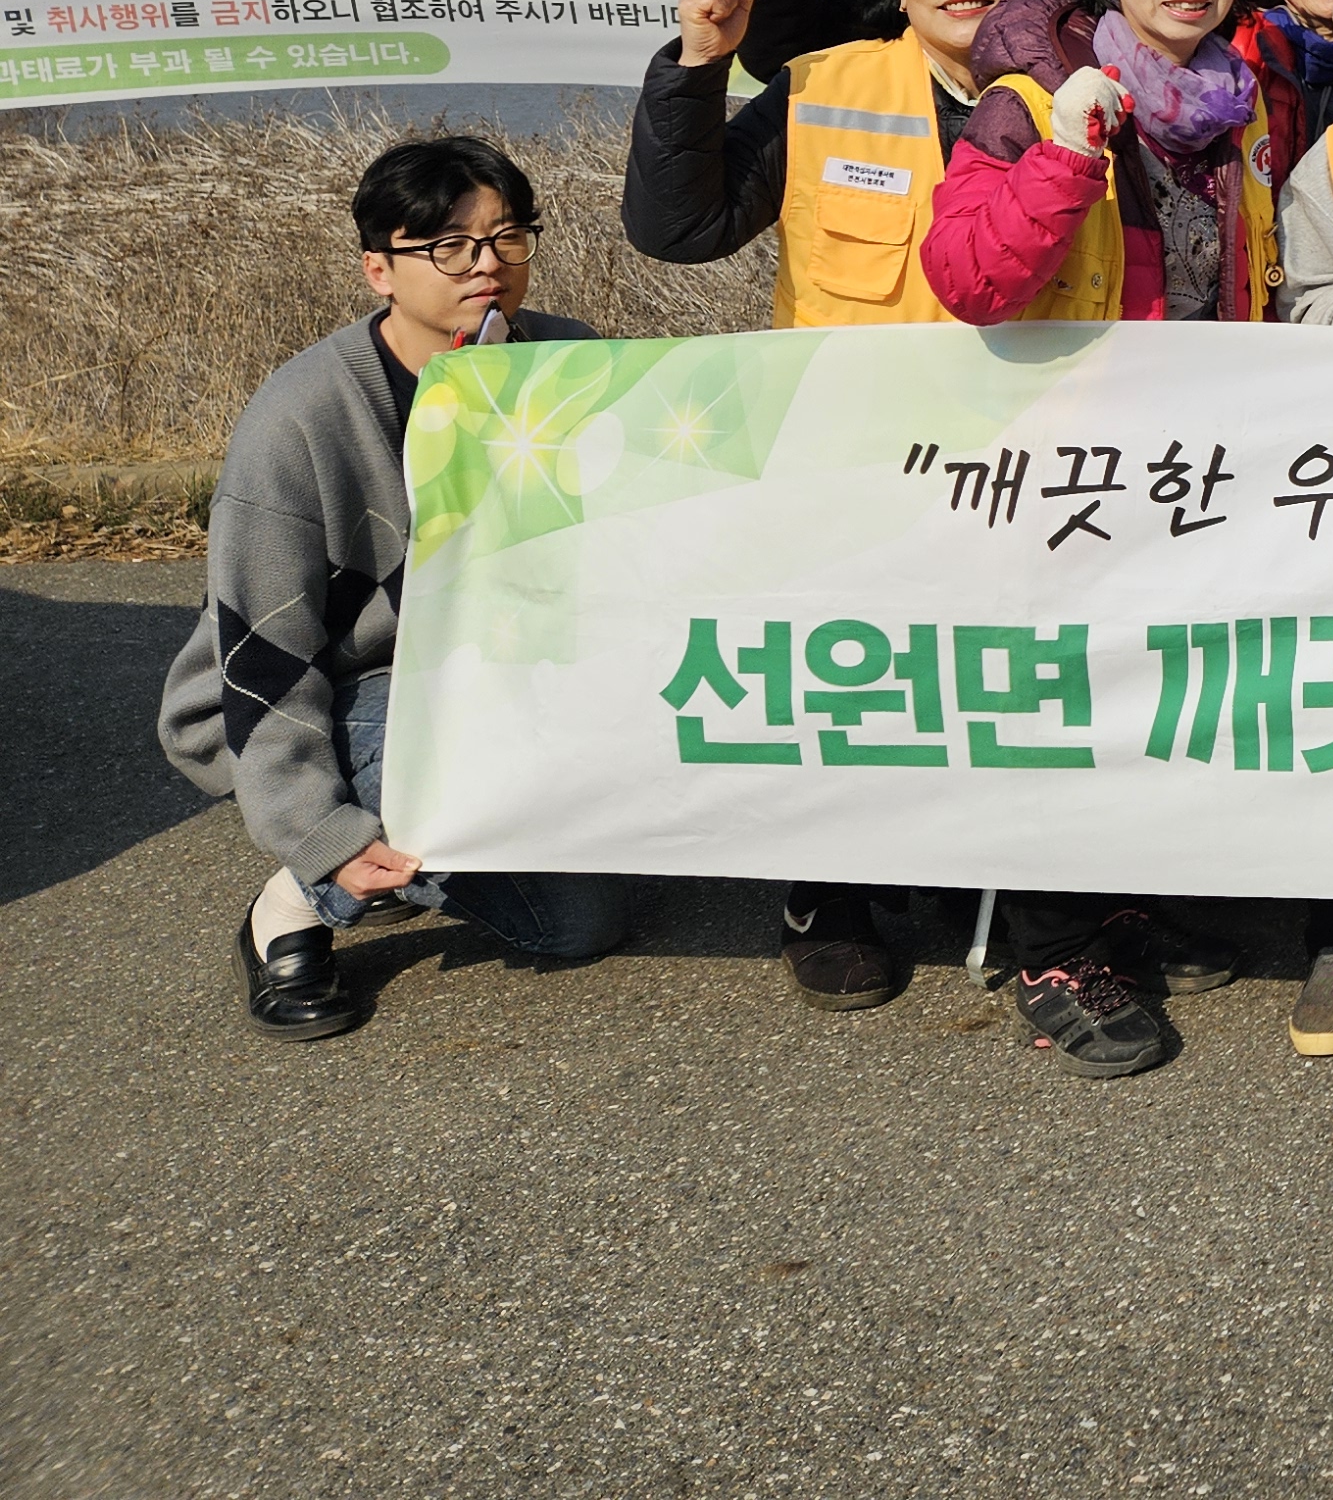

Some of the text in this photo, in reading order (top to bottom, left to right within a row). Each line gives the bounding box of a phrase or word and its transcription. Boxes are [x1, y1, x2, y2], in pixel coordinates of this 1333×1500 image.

[4, 8, 36, 36] 및
[47, 1, 200, 34] 취사행위를
[495, 0, 578, 24] 주시기
[129, 49, 192, 77] 부과
[204, 46, 235, 73] 될
[246, 45, 277, 70] 수
[287, 41, 420, 68] 있습니다.
[904, 440, 1234, 551] "깨끗한
[662, 618, 1097, 770] 선원면
